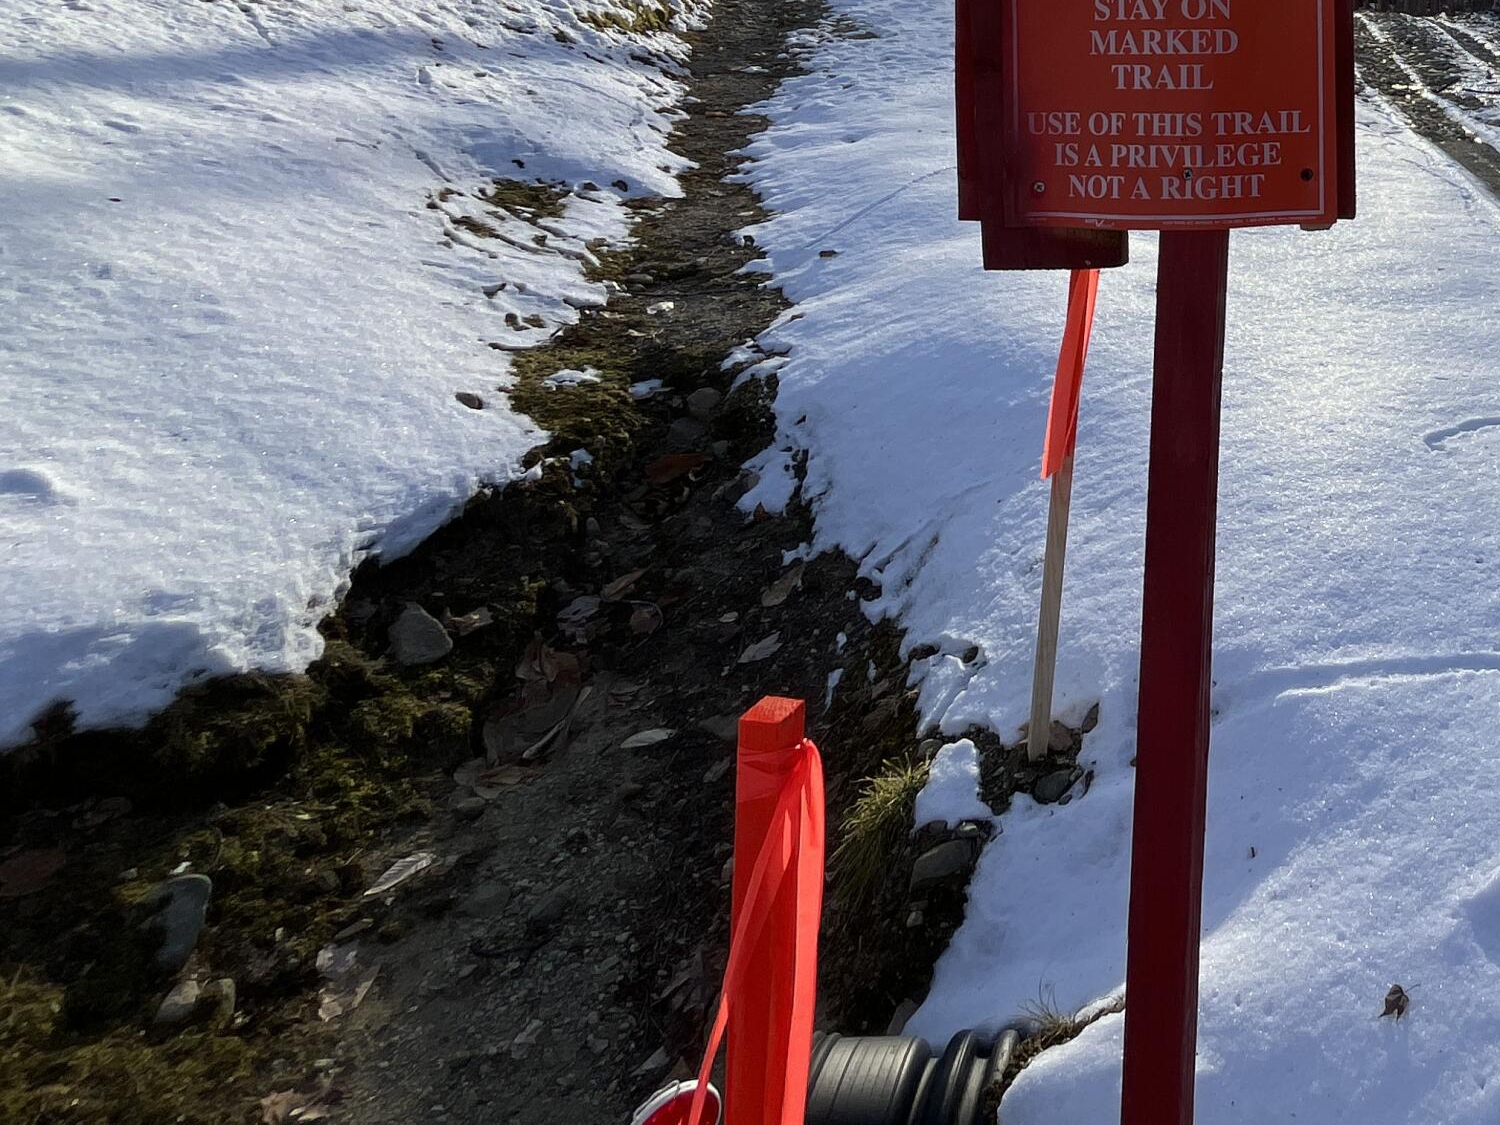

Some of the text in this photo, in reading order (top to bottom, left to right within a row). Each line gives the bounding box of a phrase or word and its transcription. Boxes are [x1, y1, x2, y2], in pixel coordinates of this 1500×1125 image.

[1089, 28, 1239, 56] MARKED
[1111, 64, 1214, 90] TRAIL
[1027, 110, 1312, 137] USE OF THIS TRAIL
[1054, 142, 1282, 169] IS A PRIVILEGE
[1068, 174, 1265, 201] NOT A RIGHT
